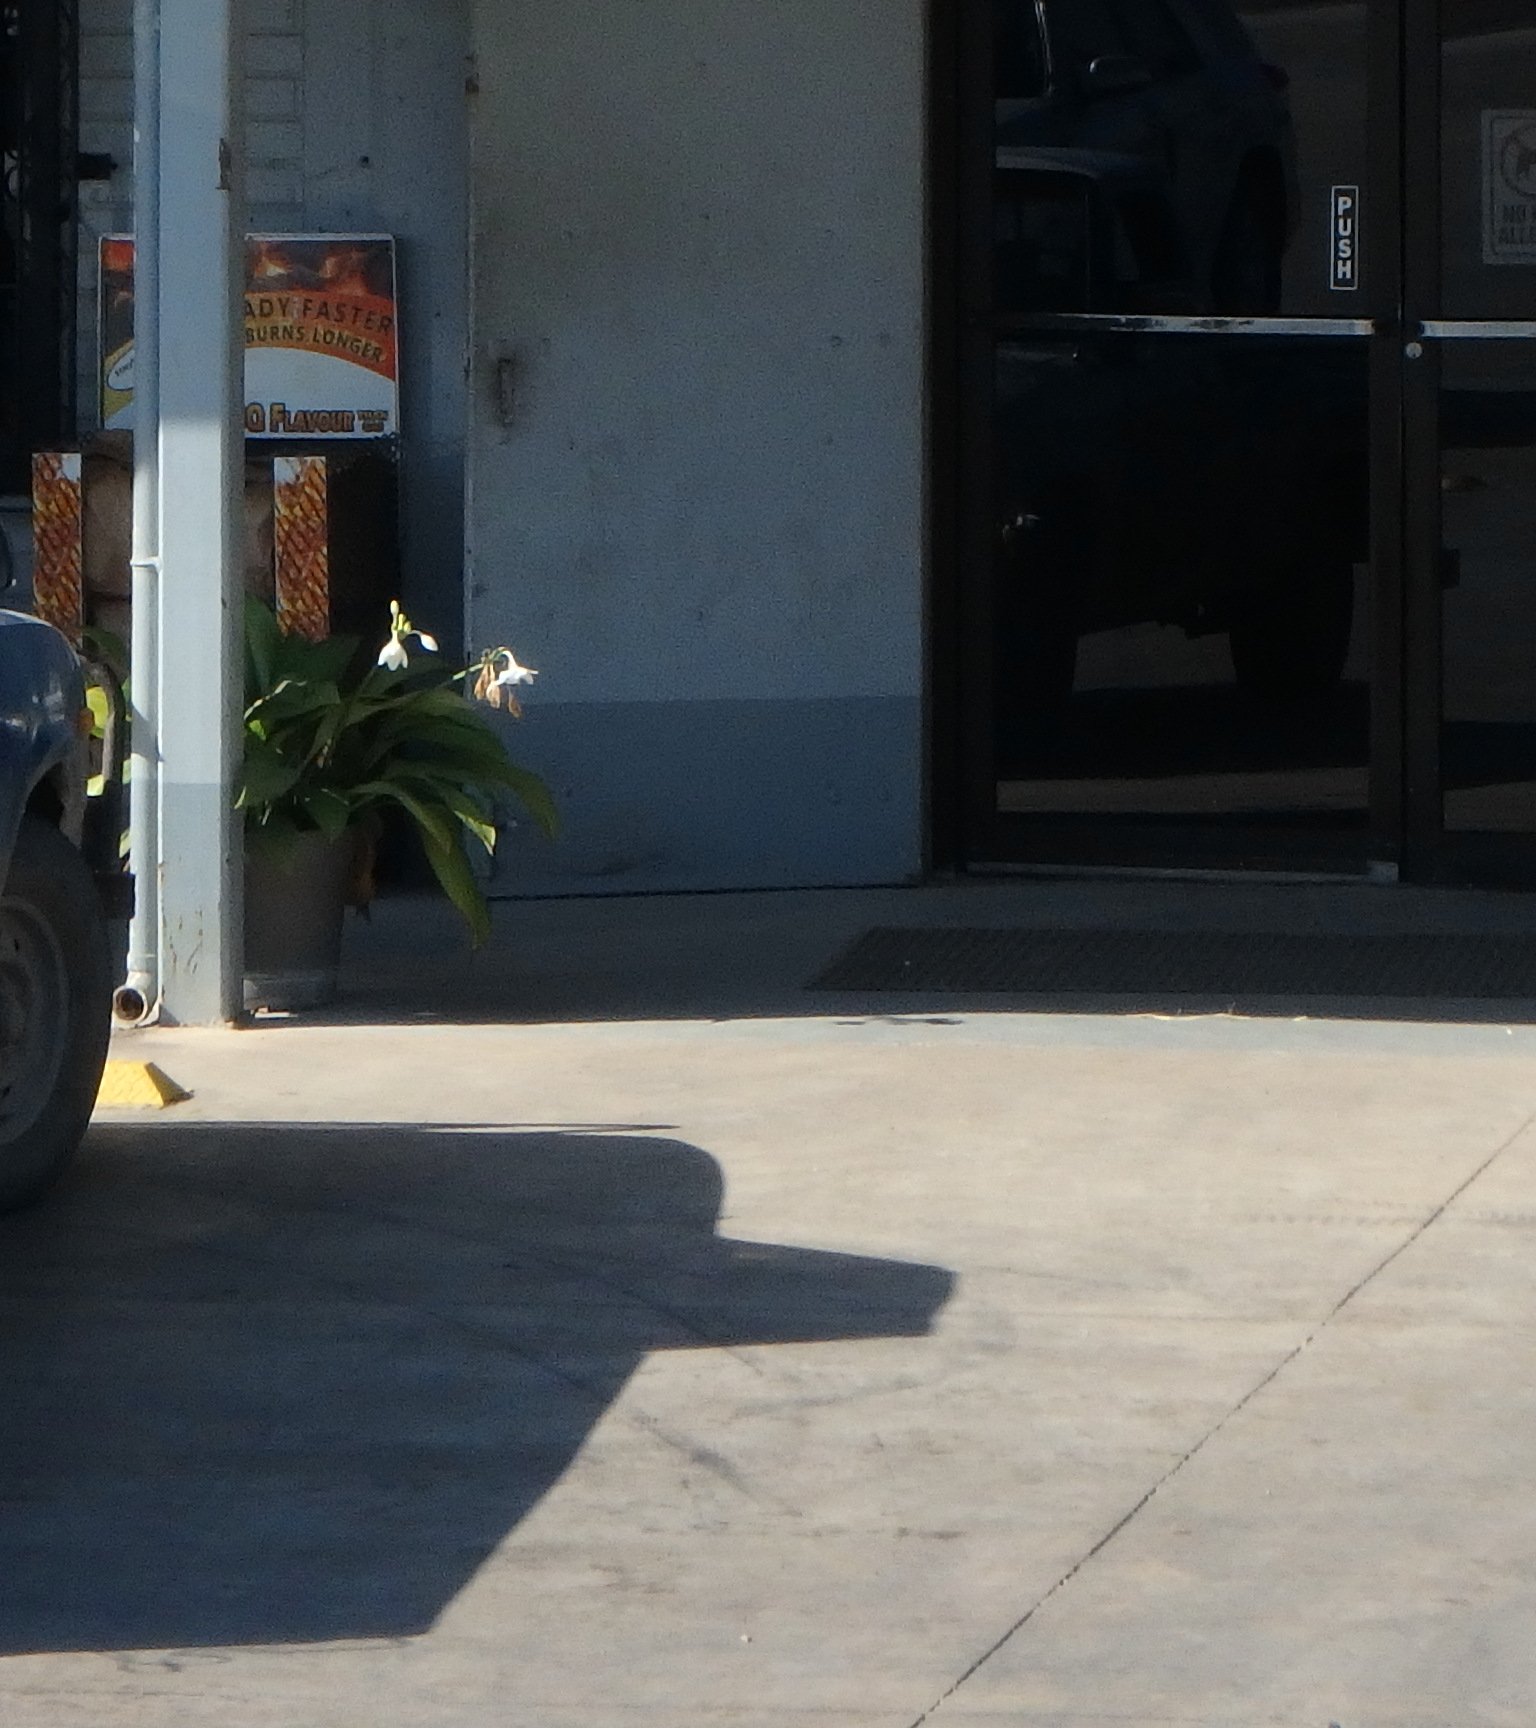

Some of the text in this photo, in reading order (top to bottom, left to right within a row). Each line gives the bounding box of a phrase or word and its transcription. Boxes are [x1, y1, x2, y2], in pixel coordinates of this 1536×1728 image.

[1502, 204, 1527, 223] NO
[1337, 196, 1352, 279] PUSH
[245, 297, 393, 337] ADY FASTER
[245, 325, 384, 363] BURNS LONGER
